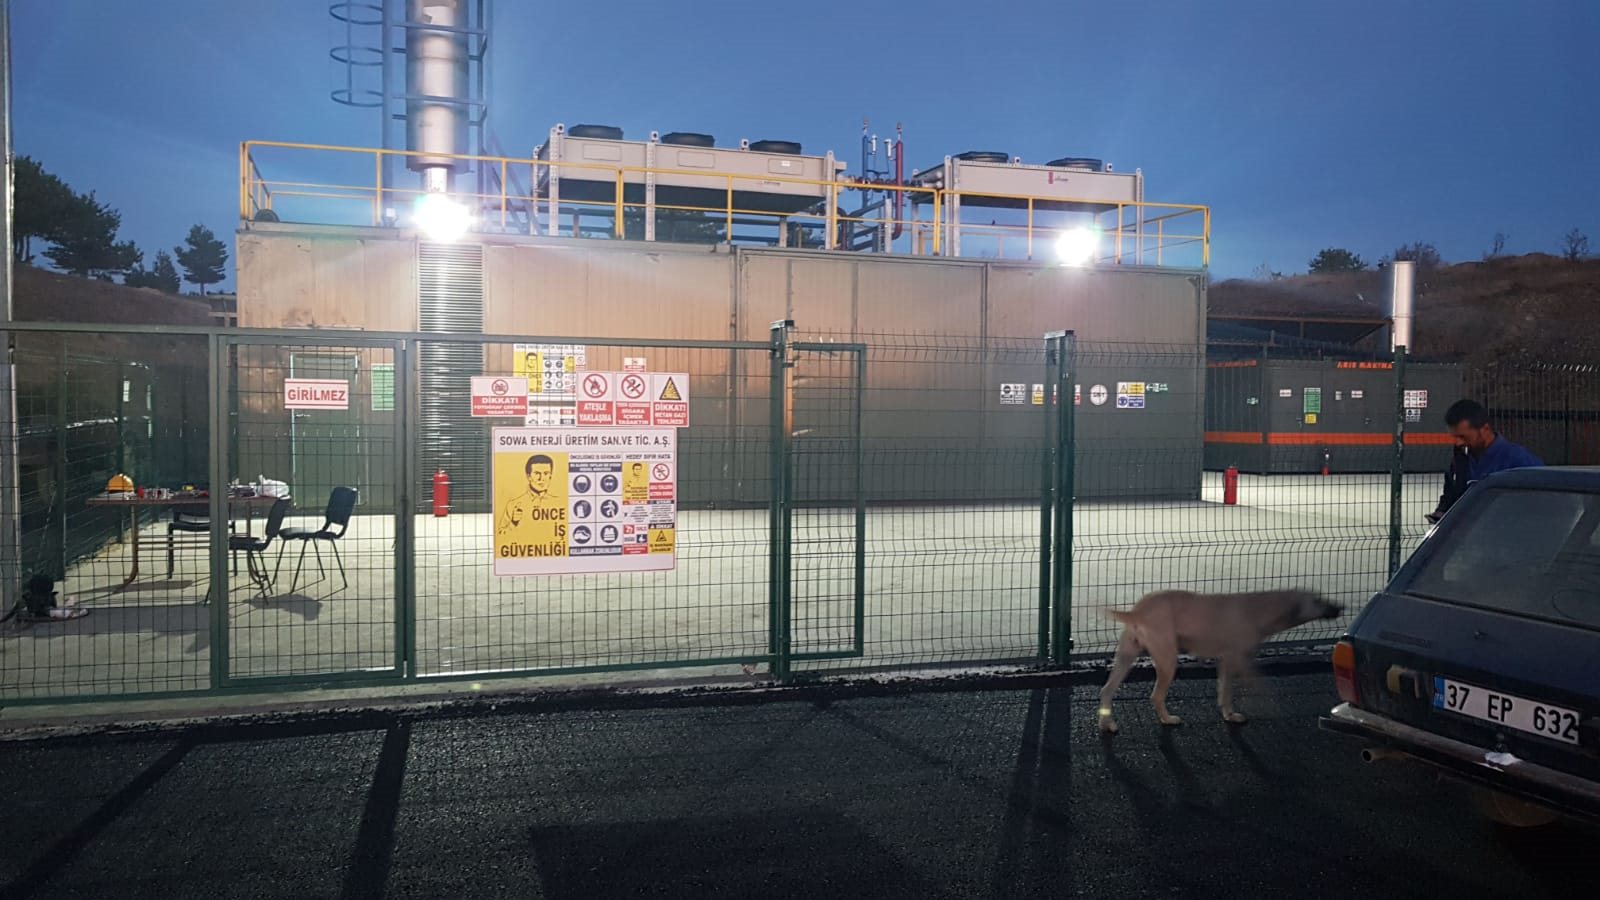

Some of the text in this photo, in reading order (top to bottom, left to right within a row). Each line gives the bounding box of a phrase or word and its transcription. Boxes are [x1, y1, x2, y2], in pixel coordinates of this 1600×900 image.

[288, 387, 346, 401] GİRİLMEZ
[584, 402, 607, 412] ATEŞLE
[579, 414, 612, 423] YAKLAŞMA
[500, 436, 528, 446] SOWA
[531, 435, 562, 446] ENERJİ
[565, 434, 599, 446] ÜRETİM
[635, 434, 652, 446] TİC.
[654, 436, 671, 448] A.Ş.
[532, 506, 566, 521] ÖNCE
[554, 525, 566, 538] İŞ
[501, 542, 566, 557] GÜVENLİĞİ
[1447, 685, 1577, 740] 37 EP 632
